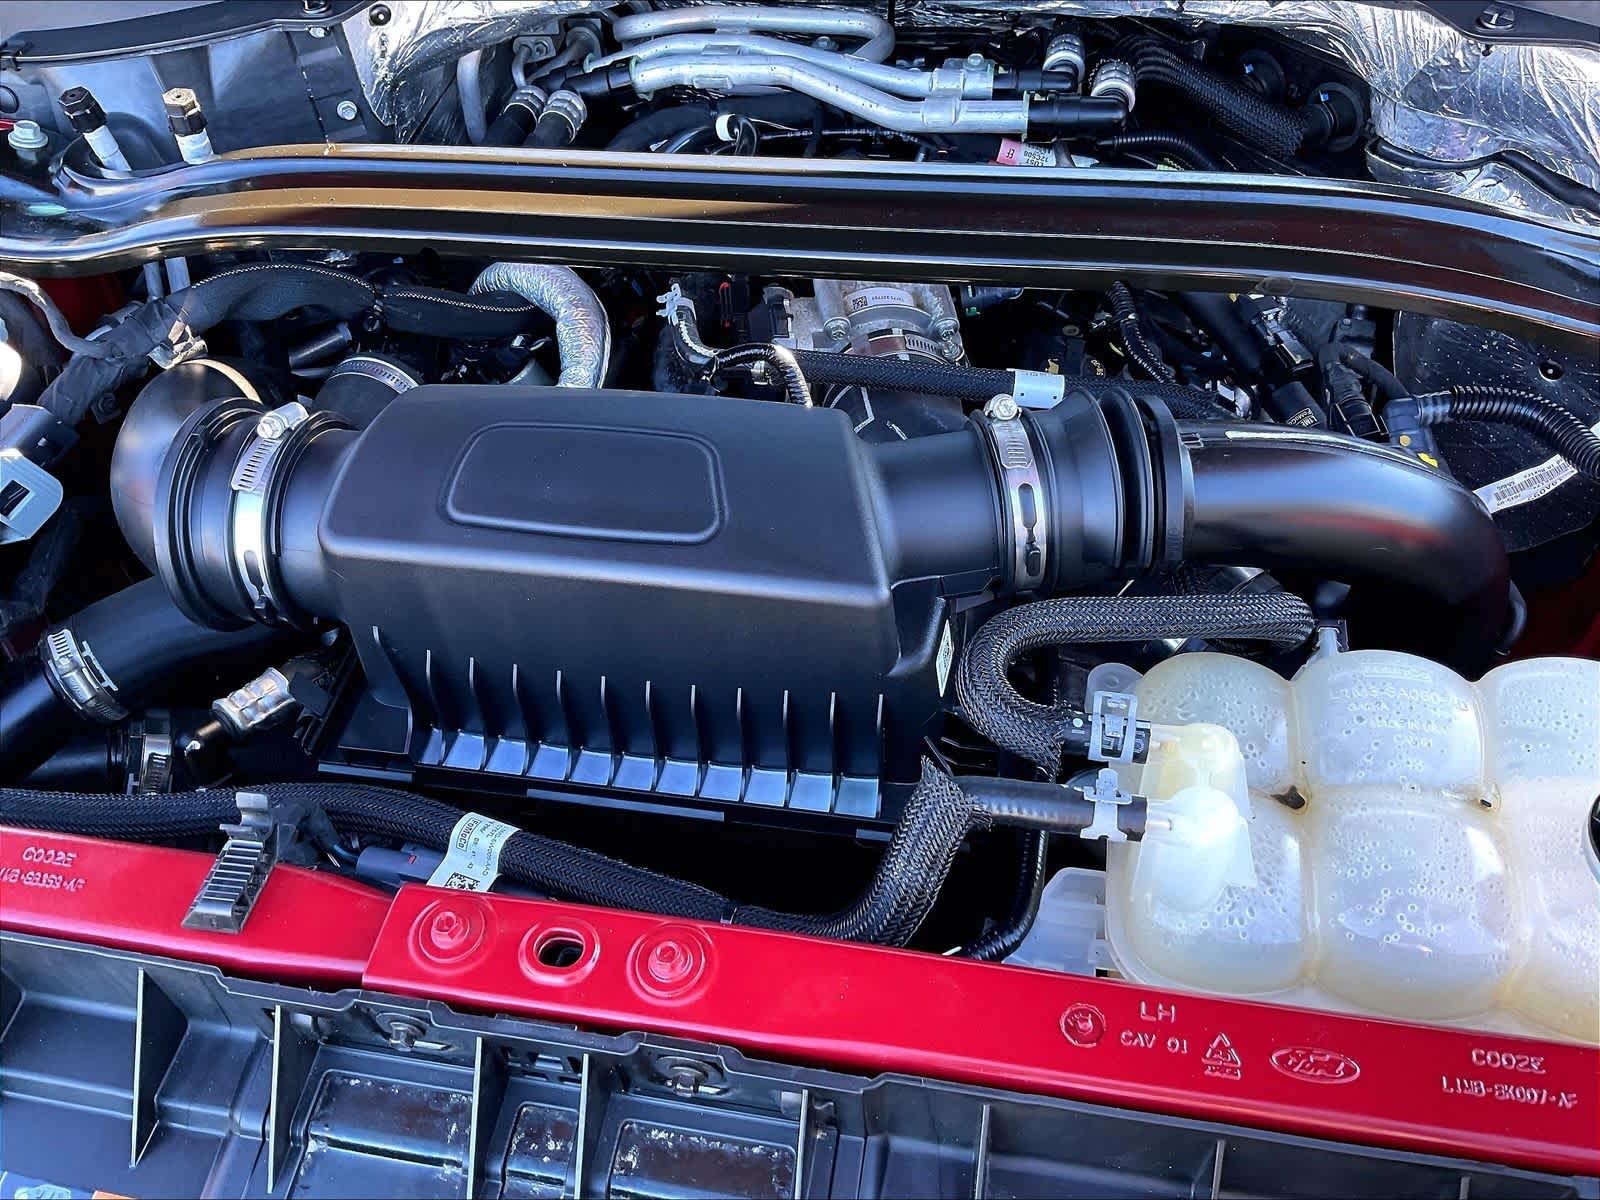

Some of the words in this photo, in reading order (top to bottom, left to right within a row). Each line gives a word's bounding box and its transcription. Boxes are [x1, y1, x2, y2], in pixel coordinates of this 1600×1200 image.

[457, 819, 480, 850] FoMoCo
[1139, 1001, 1176, 1023] LH
[1120, 1030, 1156, 1048] CAV
